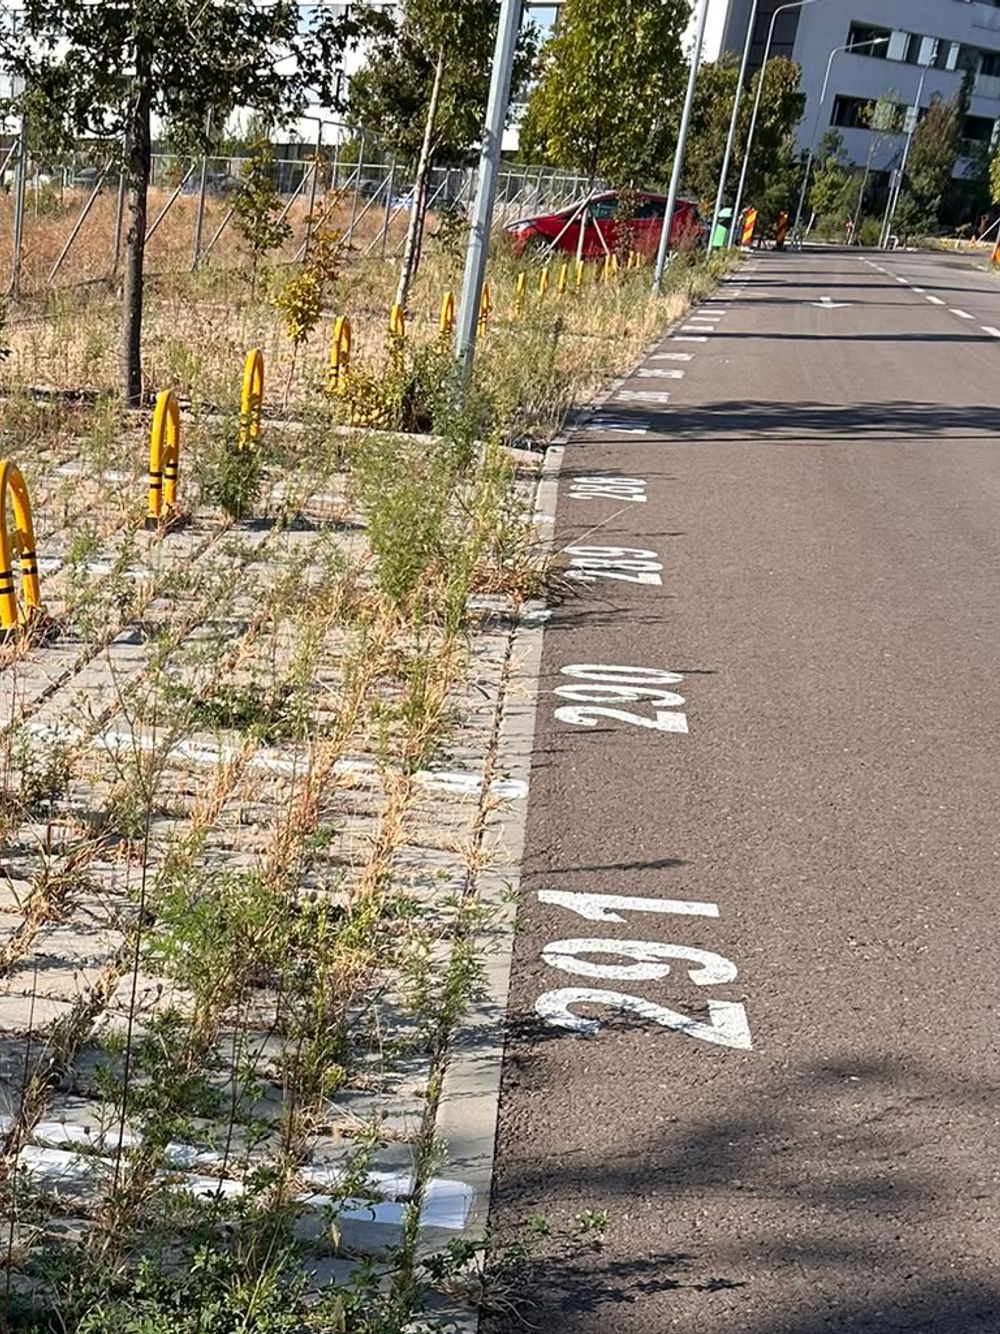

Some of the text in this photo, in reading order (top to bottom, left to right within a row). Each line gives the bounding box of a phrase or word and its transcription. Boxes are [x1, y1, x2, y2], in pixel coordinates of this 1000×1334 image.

[567, 477, 647, 502] 288
[563, 546, 663, 585] 289
[554, 664, 688, 733] 290
[535, 889, 752, 1050] 291
